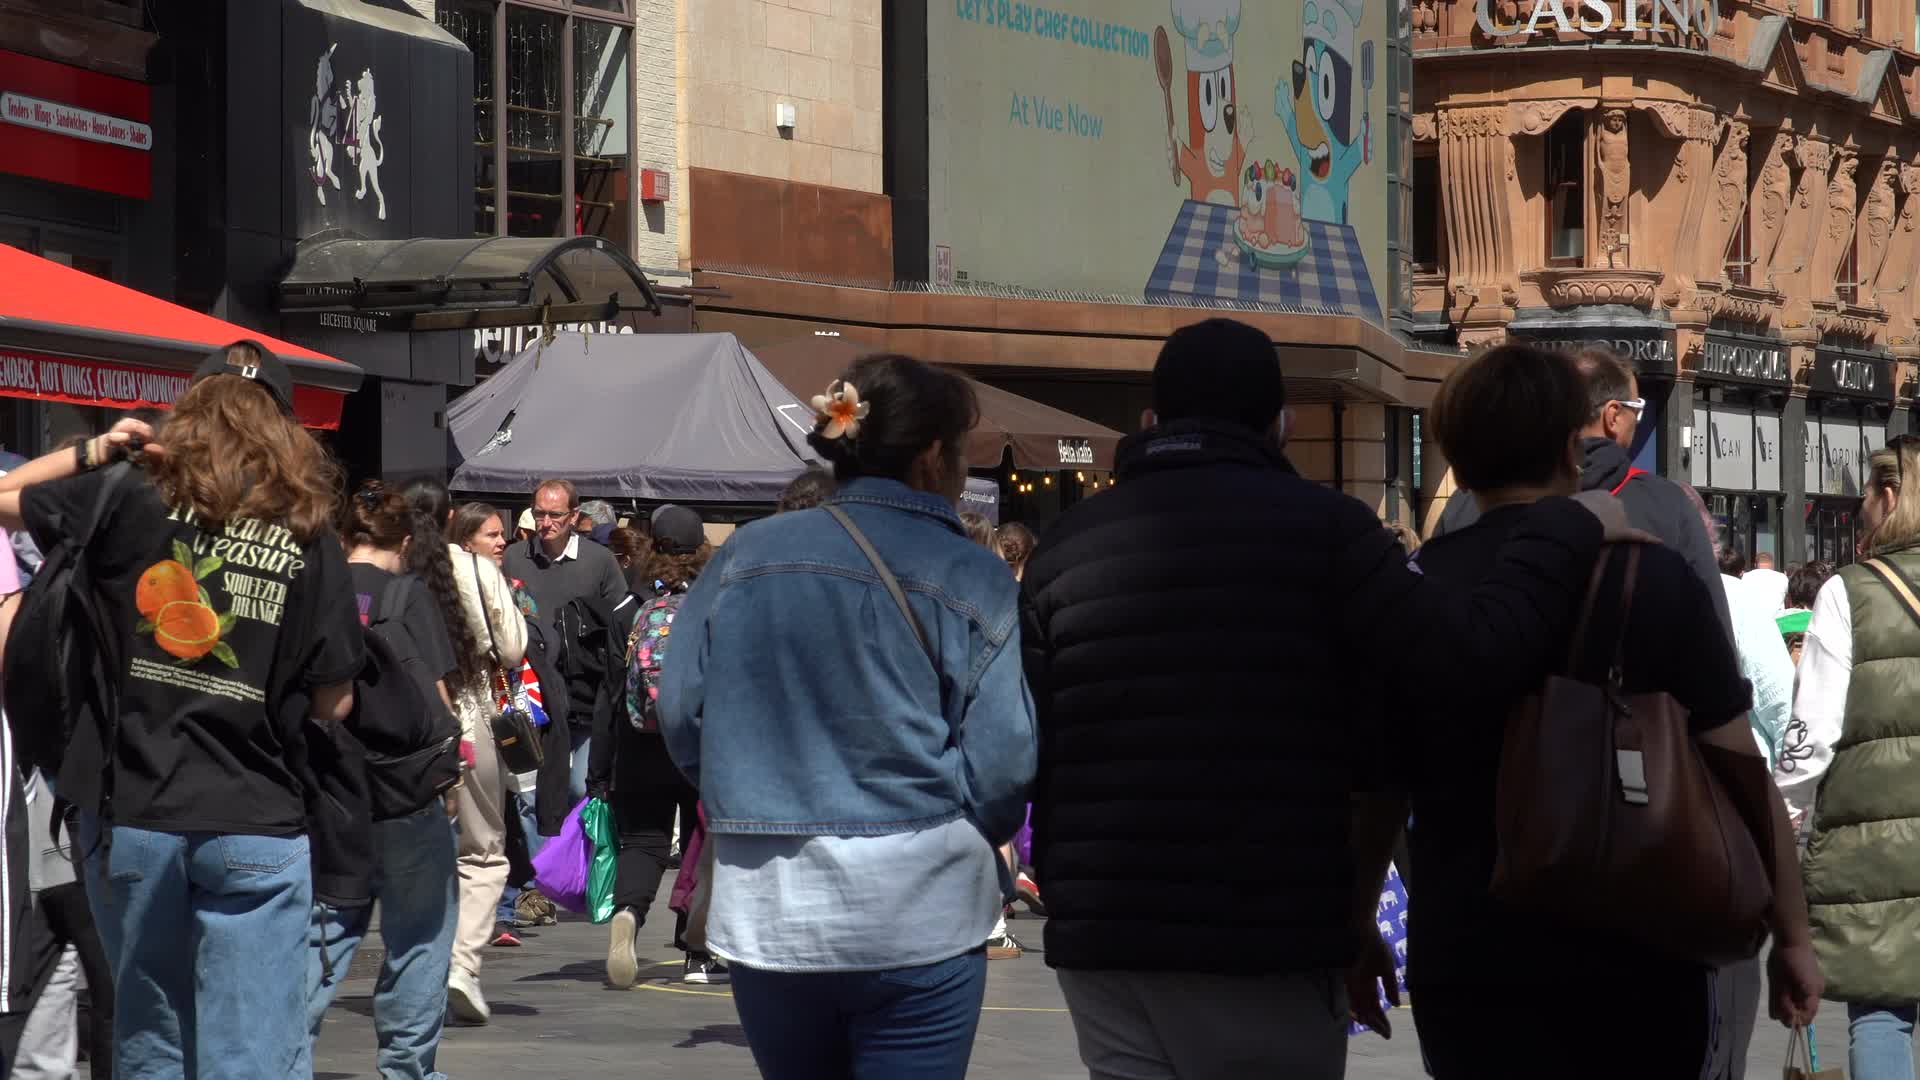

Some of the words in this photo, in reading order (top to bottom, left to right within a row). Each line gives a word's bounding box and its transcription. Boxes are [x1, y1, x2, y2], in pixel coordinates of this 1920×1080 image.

[1476, 0, 1719, 39] CASINO
[7, 97, 30, 119] Tenders
[34, 103, 52, 126] Wings
[56, 108, 88, 132] Sandwiches
[92, 116, 108, 136] House
[108, 120, 126, 140] Sauces
[129, 124, 147, 144] Shakes
[1009, 92, 1030, 125] At
[1033, 95, 1064, 131] Vue
[1068, 102, 1104, 138] Now
[320, 312, 352, 329] LEICESTER
[353, 316, 377, 334] SQUARE
[39, 360, 61, 393] HOT
[97, 368, 137, 400] CHICKEN
[1721, 437, 1742, 457] CAN
[222, 571, 288, 604] SQUEEZED
[230, 595, 285, 626] ORANGE
